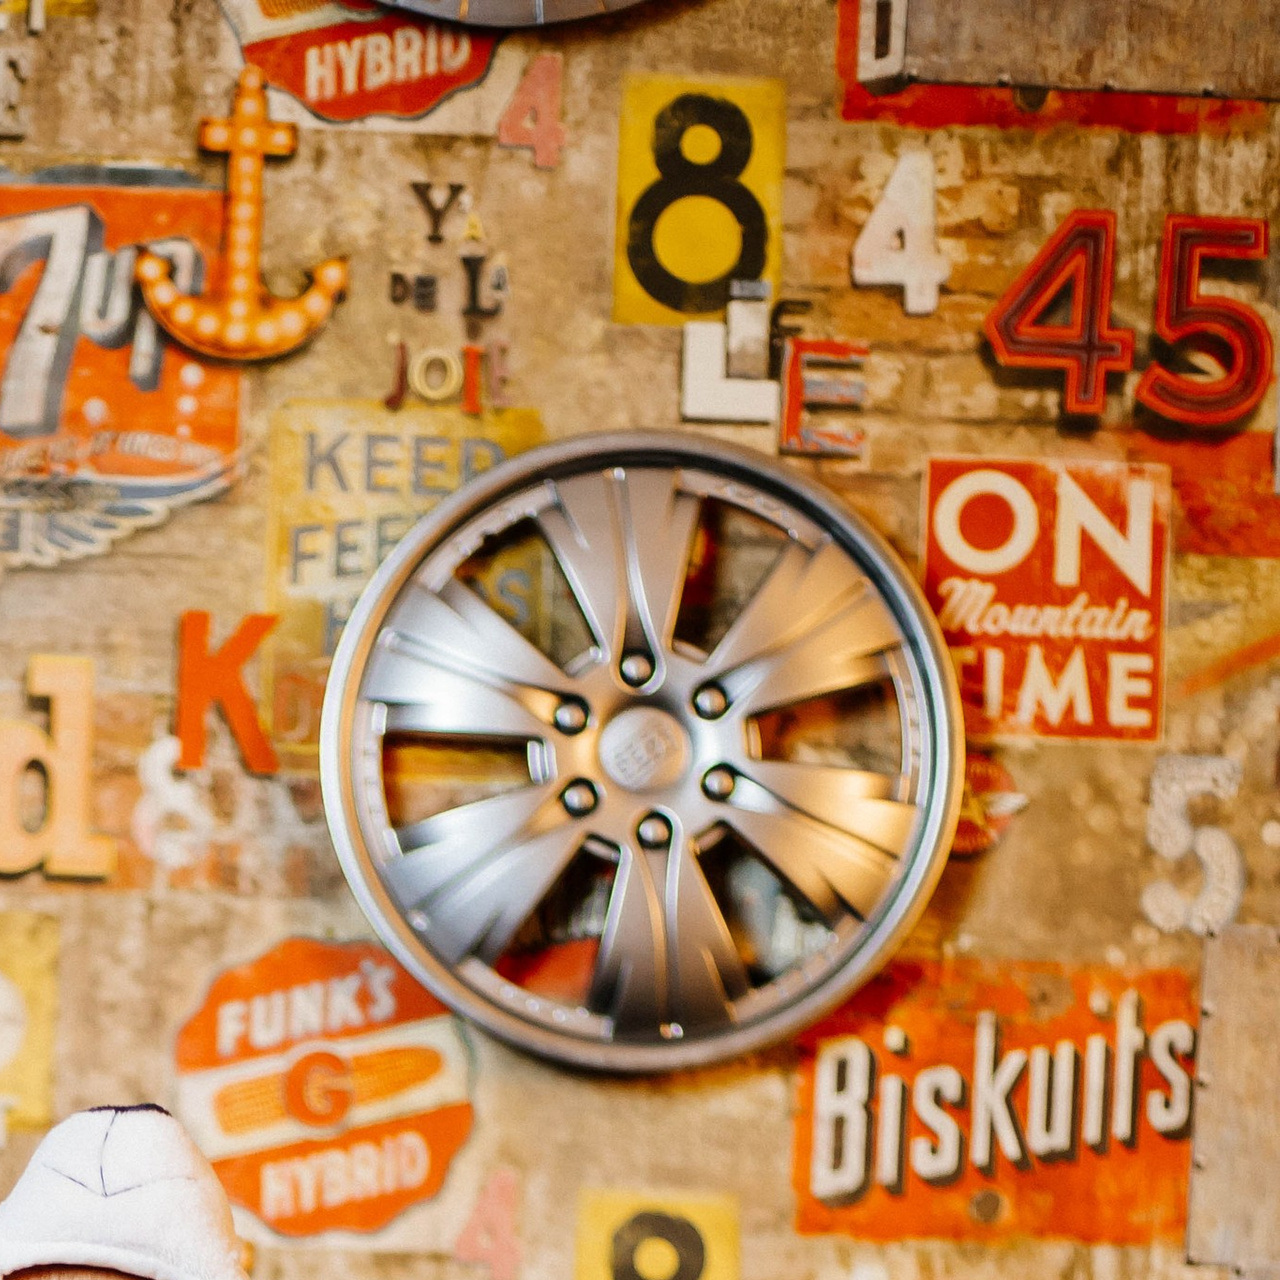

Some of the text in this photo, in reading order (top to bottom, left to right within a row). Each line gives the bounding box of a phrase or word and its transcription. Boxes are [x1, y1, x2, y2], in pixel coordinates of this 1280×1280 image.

[498, 53, 566, 170] 4
[627, 92, 770, 313] 8
[852, 148, 950, 315] 4
[287, 508, 422, 586] FEE
[932, 468, 1154, 598] ON
[937, 578, 1156, 642] Mountain
[176, 610, 280, 775] K
[1140, 752, 1244, 934] 5
[810, 988, 1196, 1198] Biskuits
